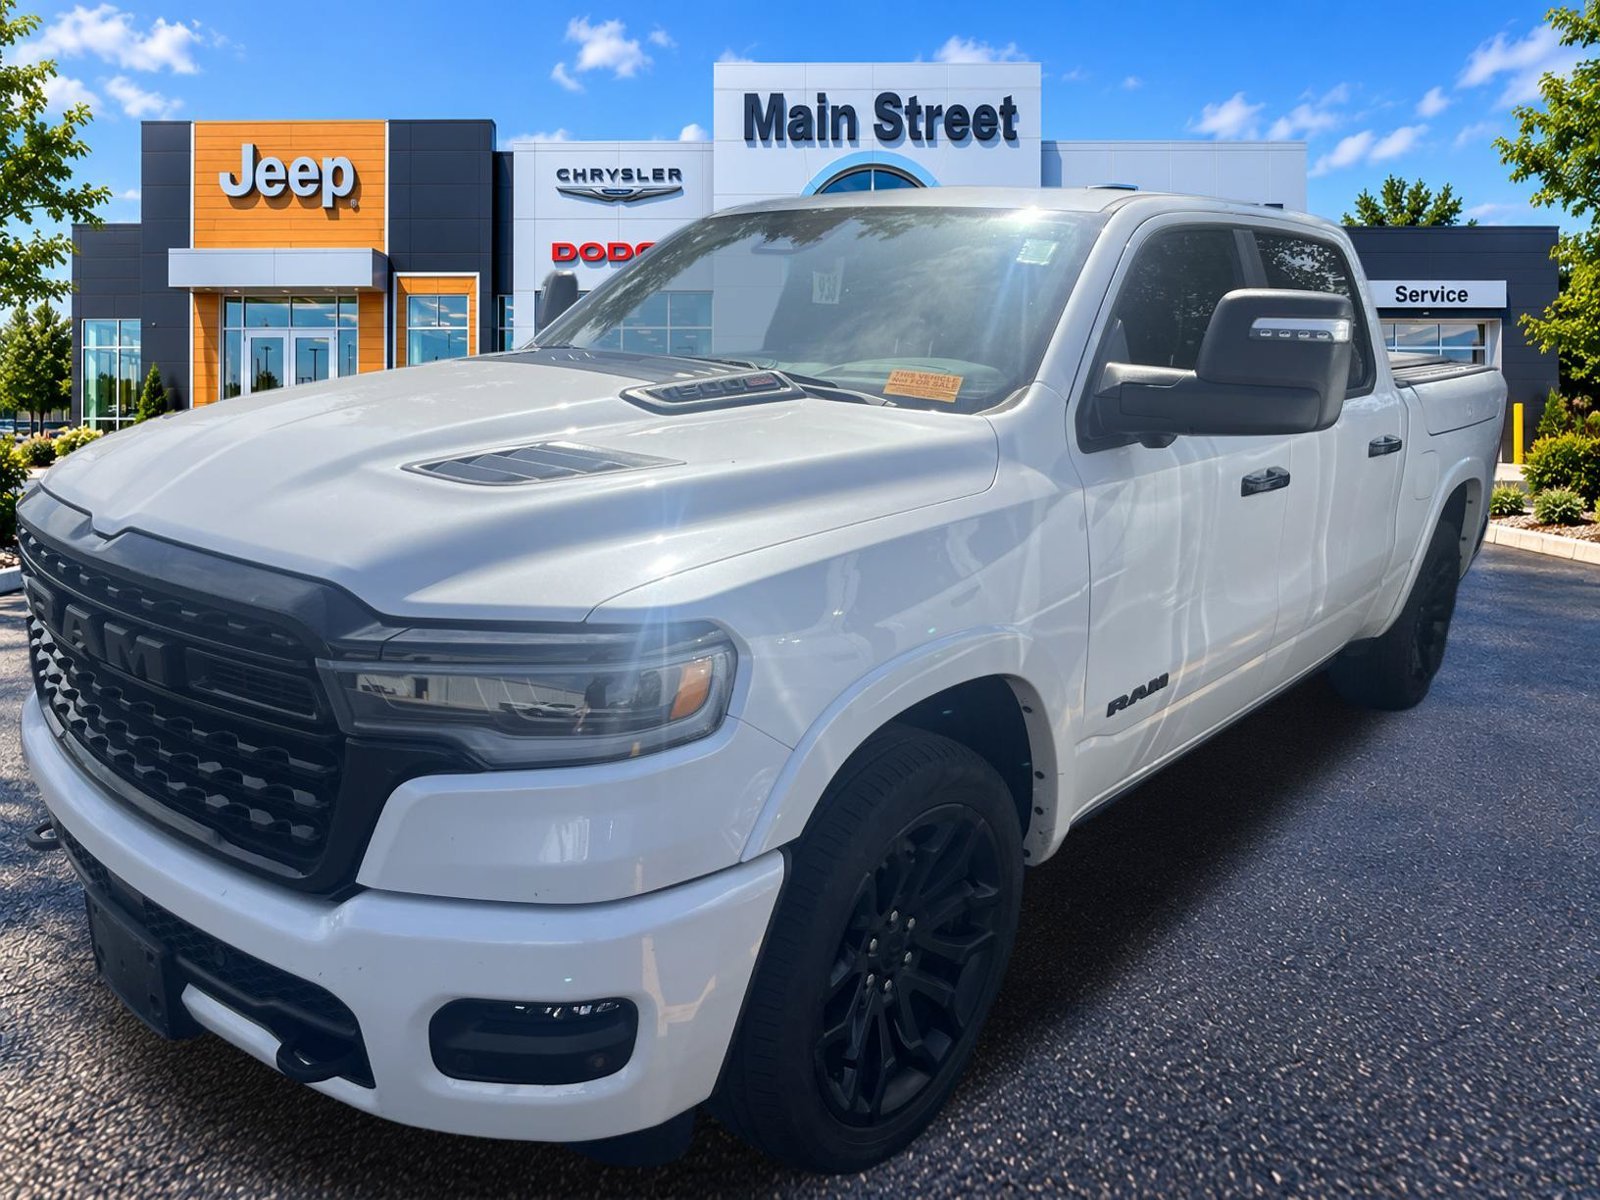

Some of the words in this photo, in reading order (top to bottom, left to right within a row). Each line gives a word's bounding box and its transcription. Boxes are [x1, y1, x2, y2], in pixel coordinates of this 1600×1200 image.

[744, 92, 857, 141] Main
[873, 92, 1018, 141] Street
[219, 143, 354, 208] Jeep
[556, 168, 683, 183] CHRYSLER
[1395, 285, 1469, 303] Service
[895, 371, 916, 379] THIS
[918, 373, 959, 383] VEHICLE
[909, 378, 930, 386] FOR
[931, 381, 959, 390] SALE
[22, 574, 168, 687] RAM
[1106, 672, 1169, 718] RAM
